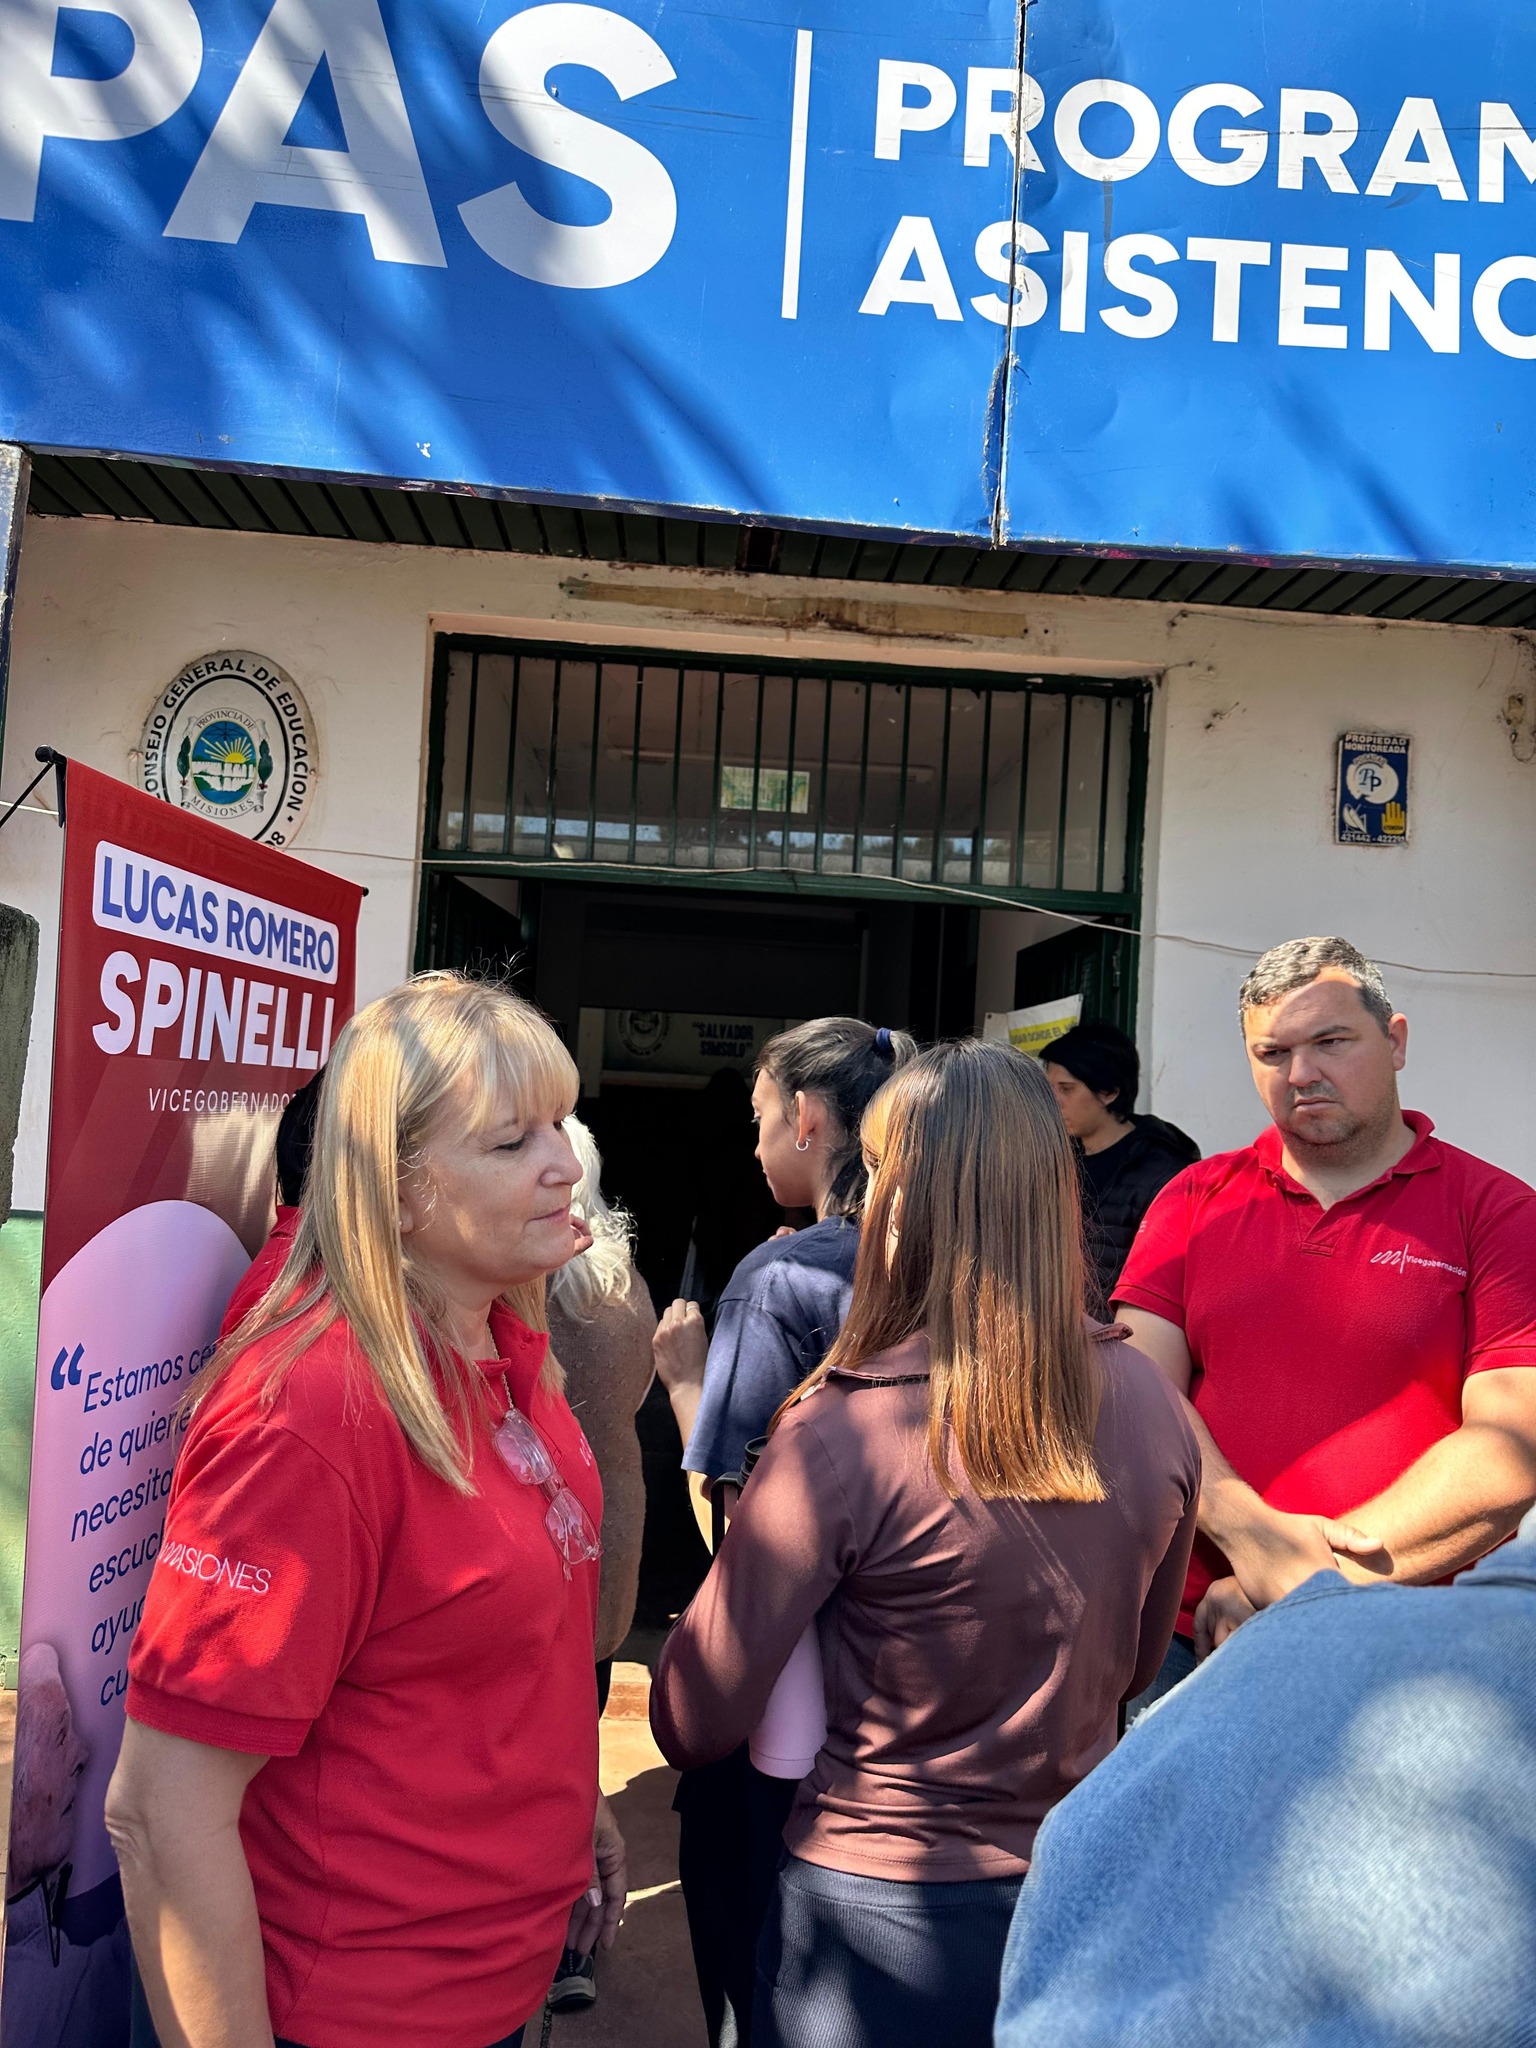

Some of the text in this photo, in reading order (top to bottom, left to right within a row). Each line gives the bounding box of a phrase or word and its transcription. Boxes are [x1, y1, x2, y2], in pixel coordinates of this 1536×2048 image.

[0, 0, 678, 289] PAS
[858, 215, 1536, 360] ASISTENC
[144, 658, 309, 812] ONSEJO GENERAL DE EDUCACION
[196, 709, 256, 731] PROVINCIA DE
[1345, 734, 1407, 746] PROPIEDAD
[1344, 742, 1407, 754] MONITOREADA
[190, 795, 255, 817] MISIONES
[101, 856, 335, 974] LUCAS ROMERO
[92, 950, 335, 1071] SPINELLI
[149, 1087, 297, 1113] VICEGOBERNADO
[80, 1431, 114, 1475] de
